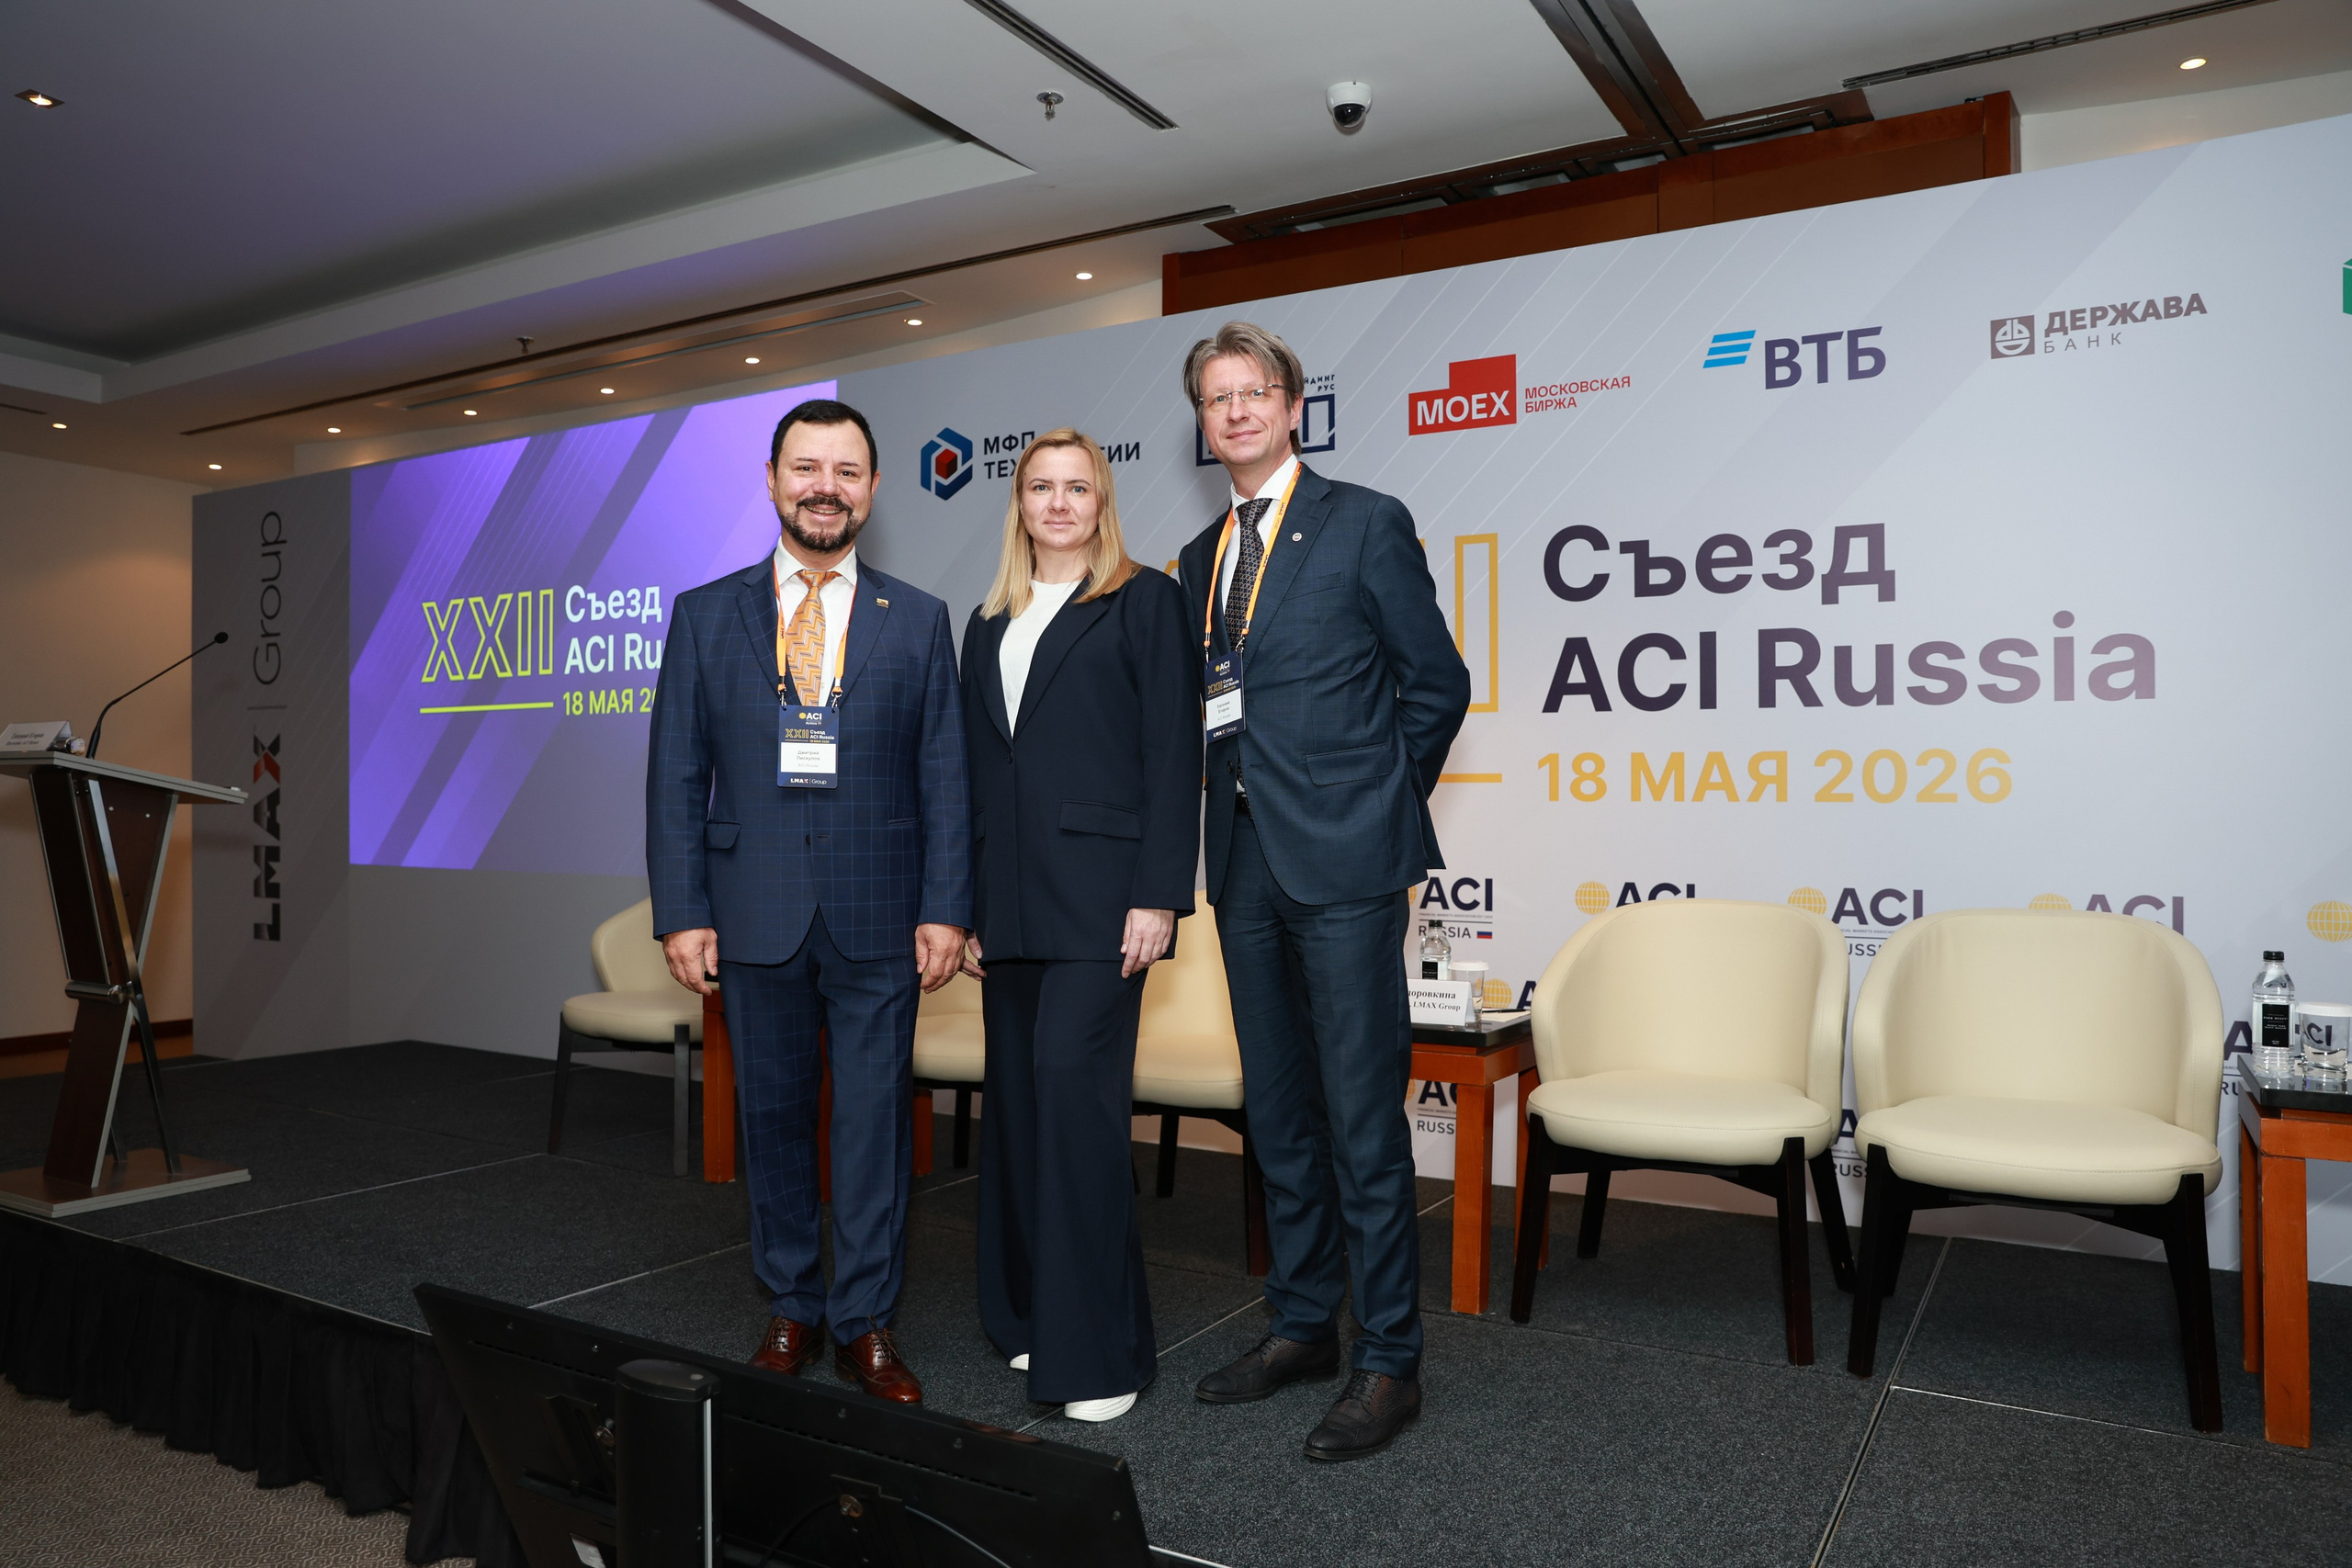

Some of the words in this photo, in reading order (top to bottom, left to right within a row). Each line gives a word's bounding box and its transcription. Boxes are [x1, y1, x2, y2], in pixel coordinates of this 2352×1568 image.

[2044, 292, 2208, 338] ДЕРЖАВА
[1764, 325, 1887, 390] ВТБ
[2043, 332, 2122, 354] БАНК
[1304, 374, 1335, 385] ЙДИНГ
[1317, 383, 1335, 392] РУС
[1524, 376, 1631, 399] МОСКОВСКАЯ
[1417, 389, 1510, 426] MOEX
[1524, 396, 1577, 413] БИРЖА
[983, 431, 1035, 456] МФП
[1543, 523, 1896, 605] Съезд
[253, 511, 288, 685] Group
[564, 584, 662, 624] Съезд
[421, 589, 554, 682] XXII
[563, 634, 615, 675] ACI
[624, 632, 663, 671] Ru
[1220, 660, 1230, 671] ACI
[1542, 630, 1718, 714] ACI
[1758, 610, 2156, 708] Russia
[562, 690, 583, 716] 18
[589, 688, 634, 715] МАЯ
[639, 687, 656, 713] 2
[1537, 751, 1608, 802] 18
[1630, 750, 1789, 803] МАЯ
[1813, 748, 2013, 805] 2026
[253, 732, 281, 942] LMAX
[1419, 876, 1493, 912] ACI
[1831, 887, 1924, 927] ACI
[1419, 925, 1472, 939] RSSIA
[1413, 1001, 1437, 1010] LMAX
[1438, 1002, 1461, 1012] Group
[1417, 1120, 1455, 1135] RUSS
